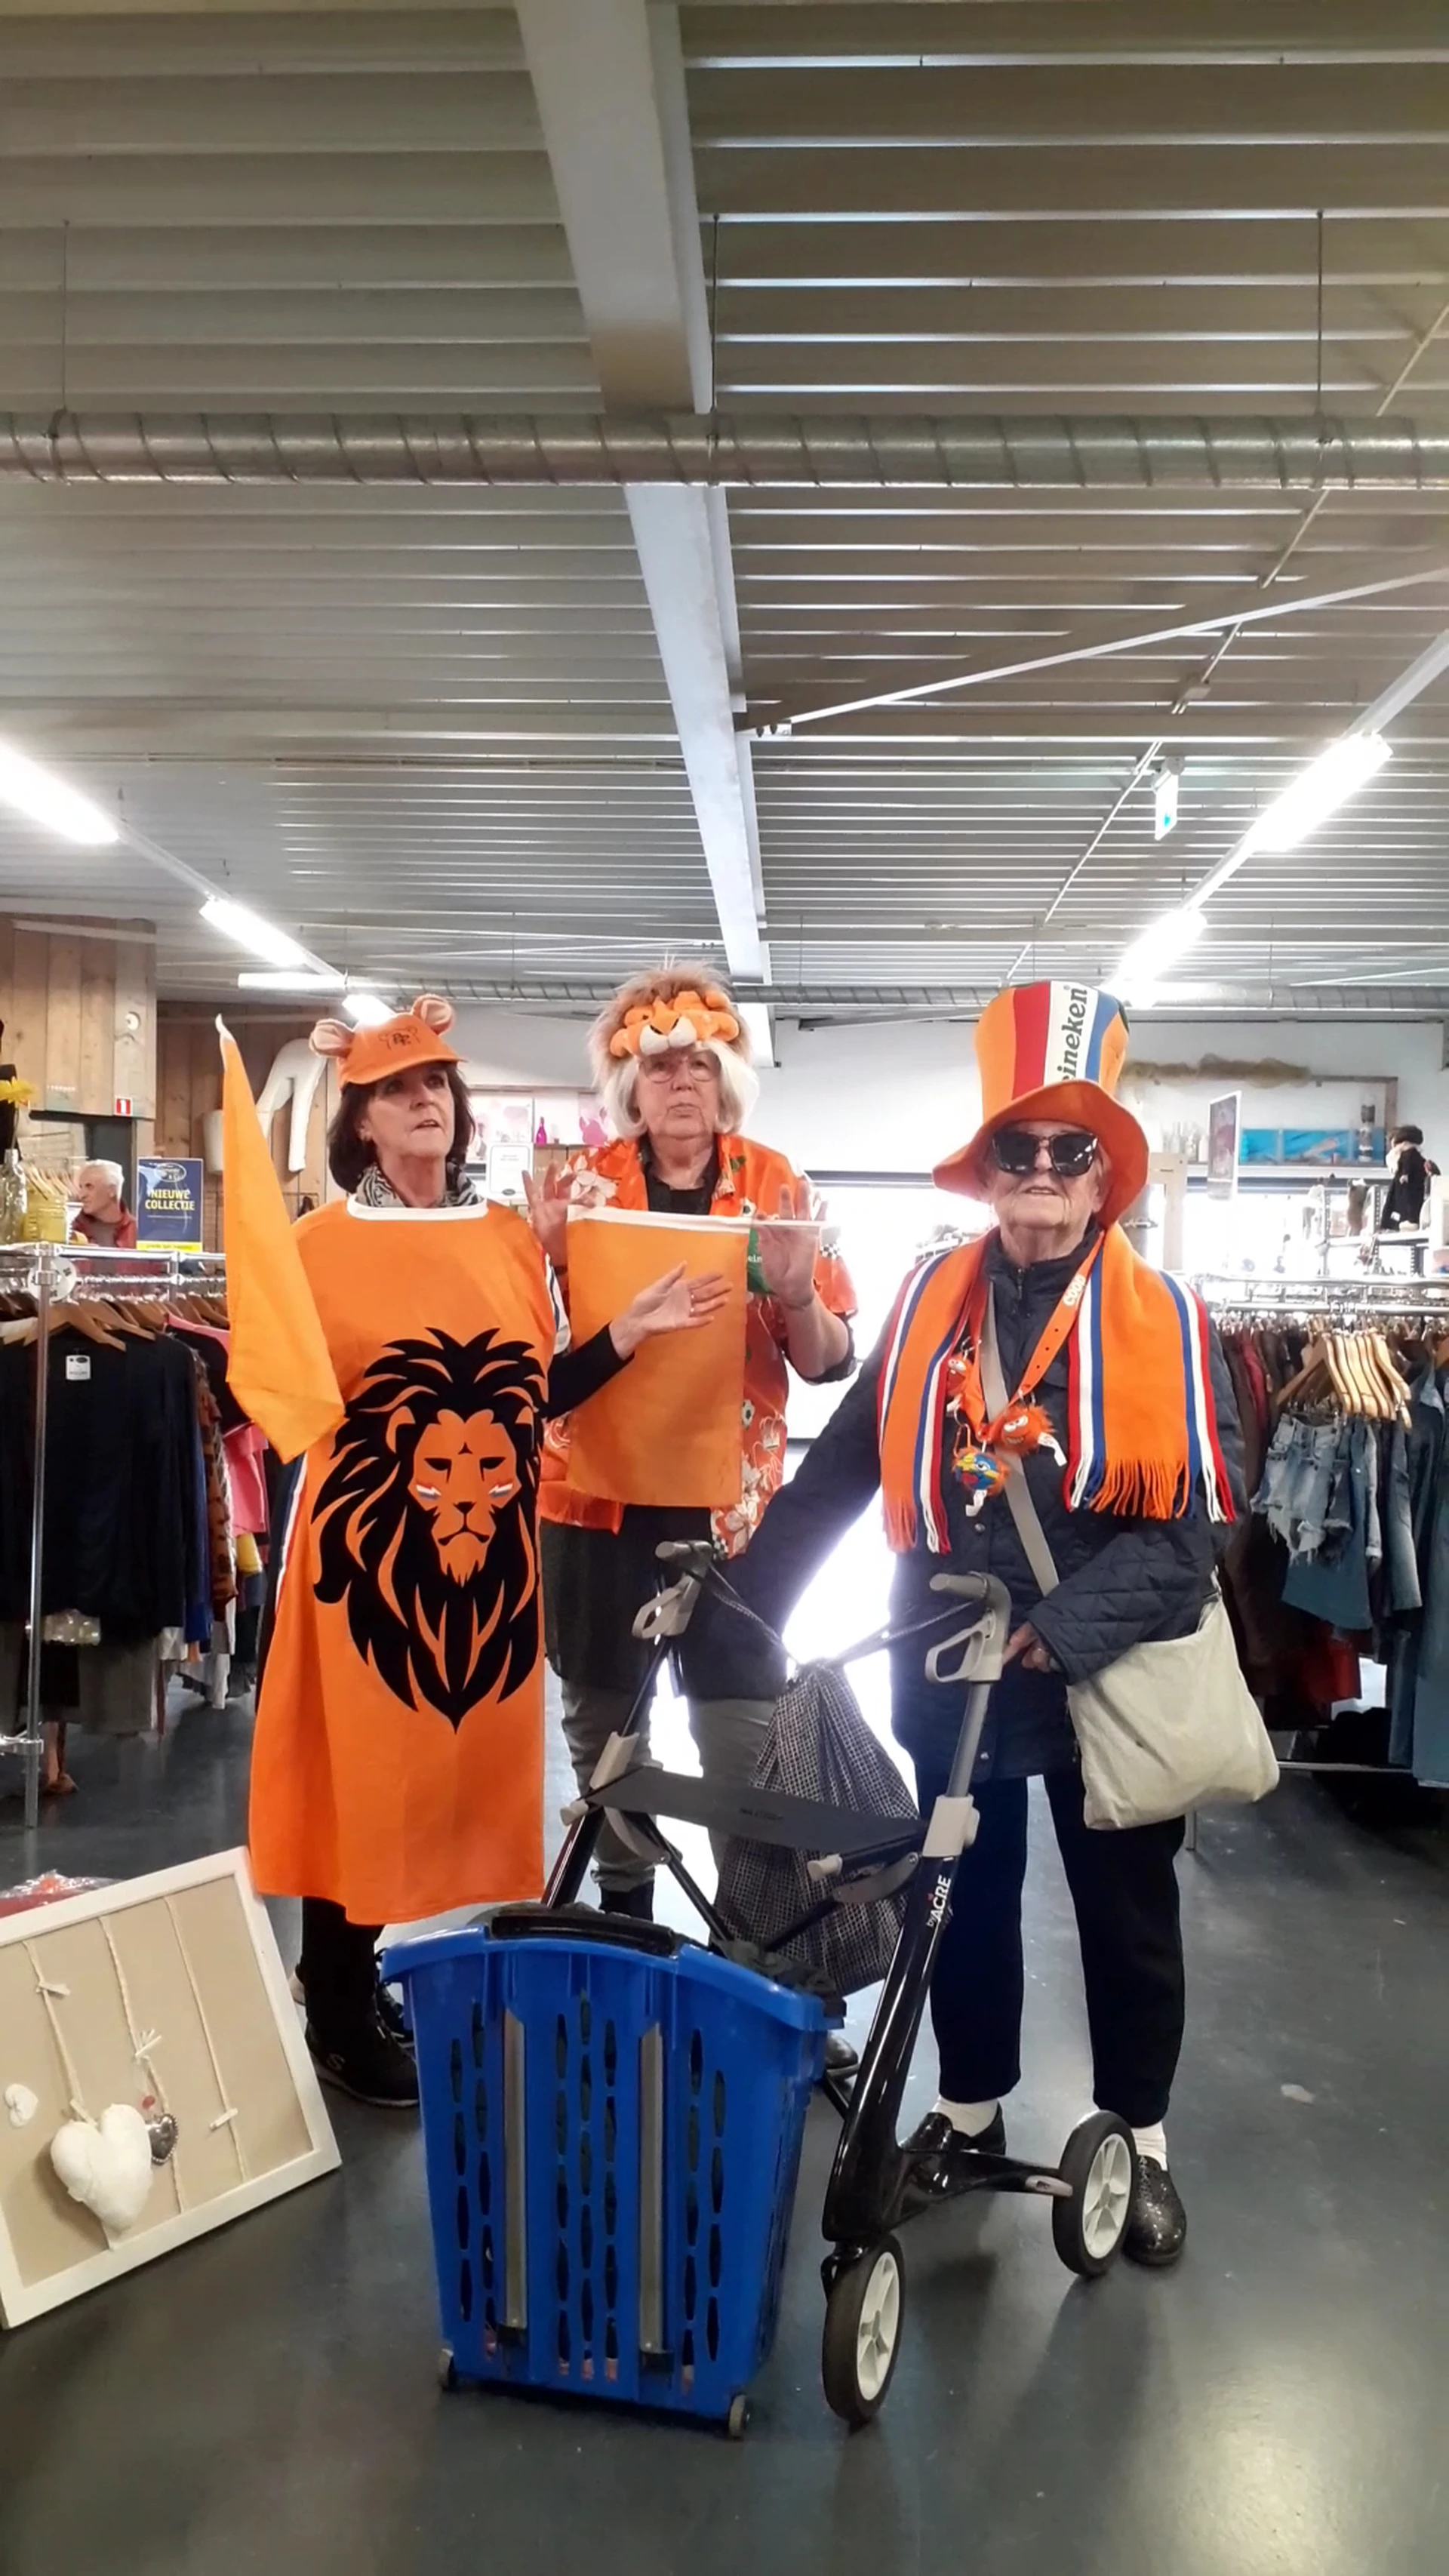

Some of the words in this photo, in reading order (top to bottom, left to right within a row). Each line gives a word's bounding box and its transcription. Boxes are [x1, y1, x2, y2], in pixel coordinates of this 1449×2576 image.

[1057, 987, 1088, 1081] ineken
[150, 1189, 190, 1199] NIEUWE
[145, 1199, 195, 1211] COLLECTIE
